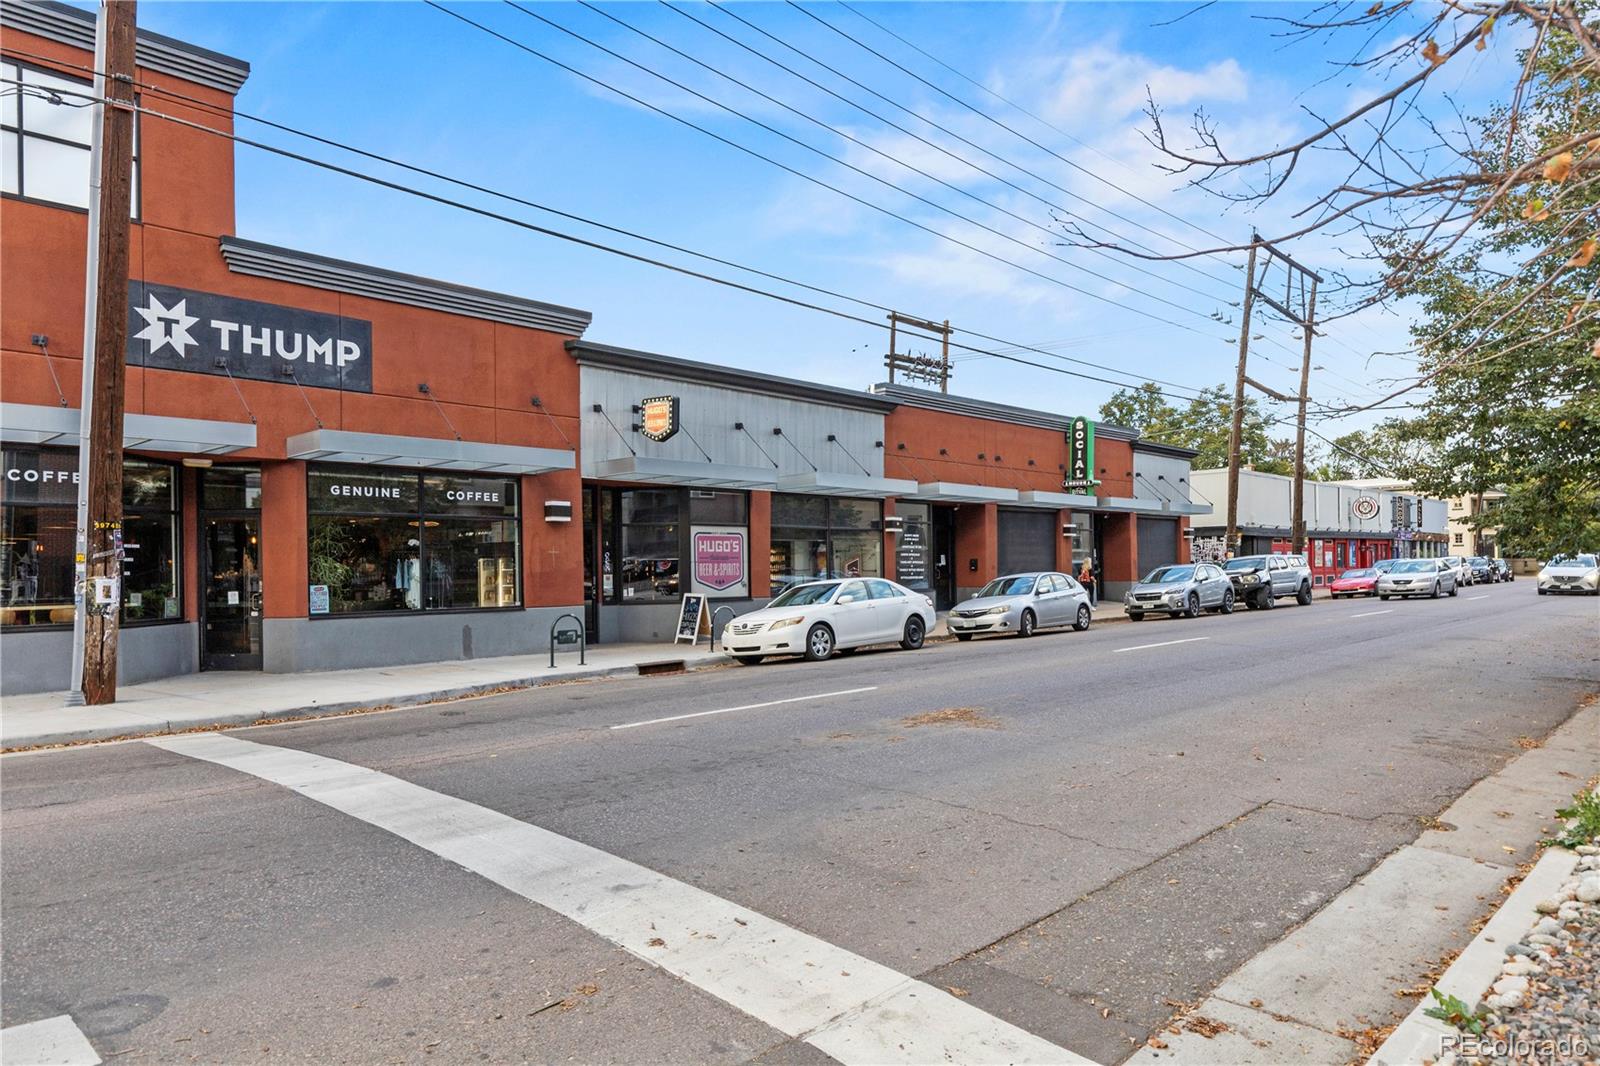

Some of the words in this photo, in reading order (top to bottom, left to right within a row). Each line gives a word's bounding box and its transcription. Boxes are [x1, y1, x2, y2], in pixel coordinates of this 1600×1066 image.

[210, 319, 361, 367] THUMP
[1074, 421, 1085, 478] SOCIAL
[7, 468, 80, 484] COFFE
[330, 485, 401, 499] GENUINE
[446, 490, 500, 502] COFFEE
[699, 540, 740, 552] HUGO'S
